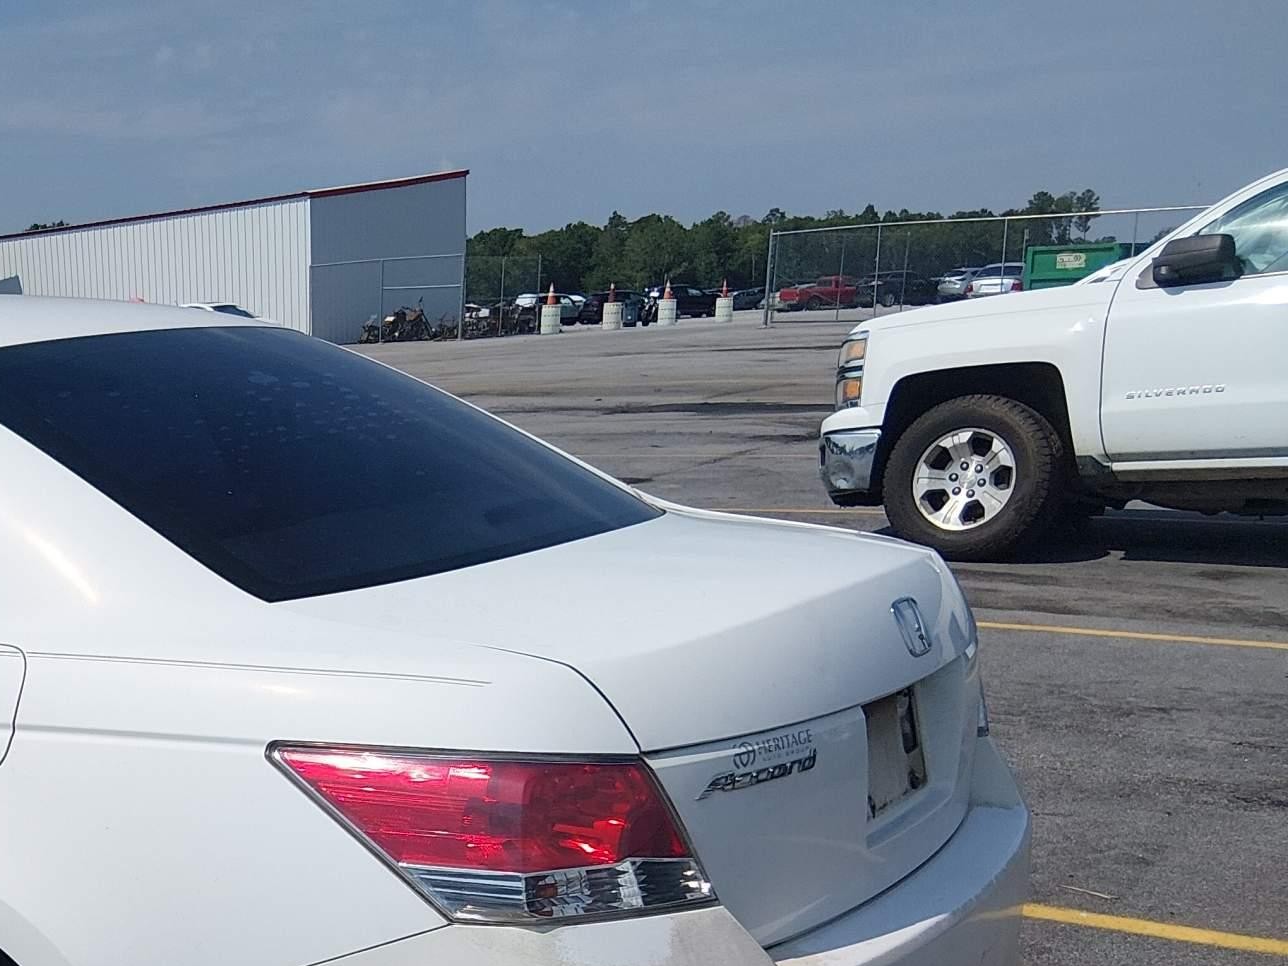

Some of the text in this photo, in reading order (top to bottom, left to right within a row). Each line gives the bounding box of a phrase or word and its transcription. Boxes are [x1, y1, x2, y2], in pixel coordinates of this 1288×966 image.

[1124, 384, 1225, 400] SILVERADO
[756, 729, 813, 755] HERITAGE
[695, 748, 816, 800] Accord
